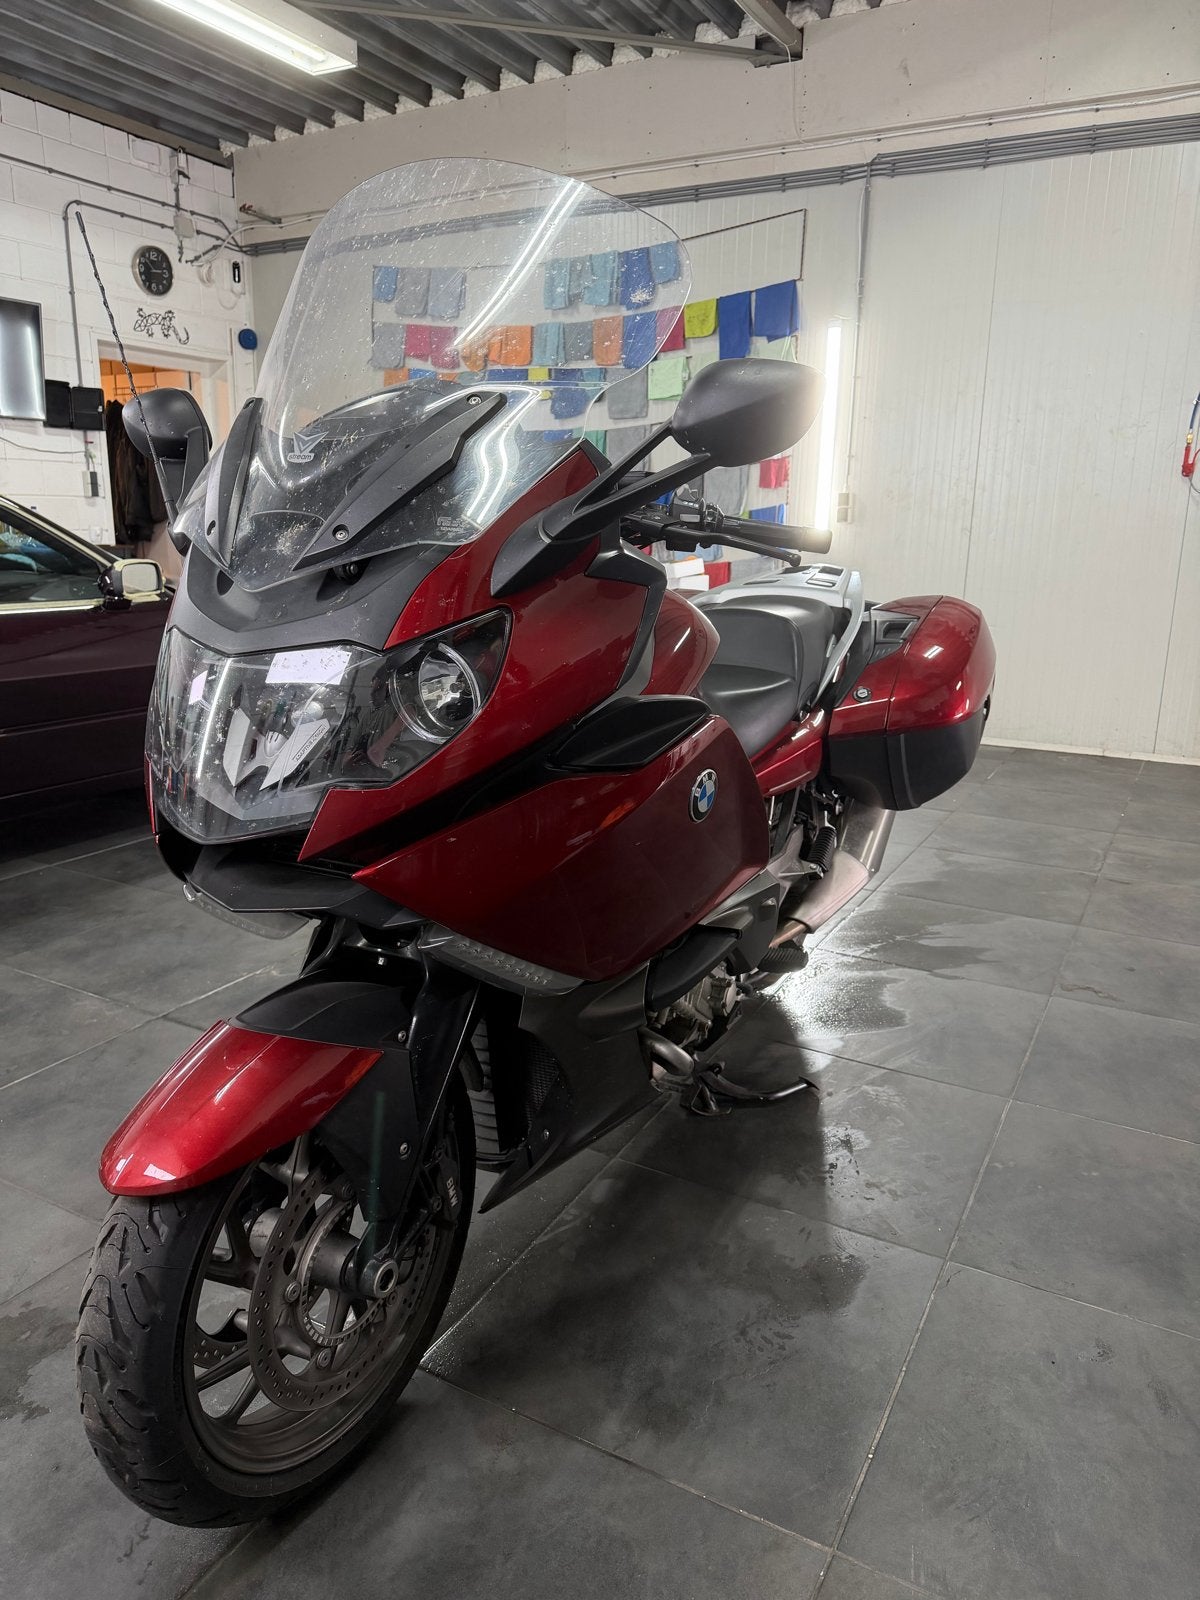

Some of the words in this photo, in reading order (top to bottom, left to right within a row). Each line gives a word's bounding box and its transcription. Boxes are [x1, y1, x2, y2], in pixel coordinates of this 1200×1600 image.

[150, 251, 157, 260] 12
[162, 269, 169, 278] 3
[151, 282, 157, 291] 6
[446, 1176, 459, 1208] BMW
